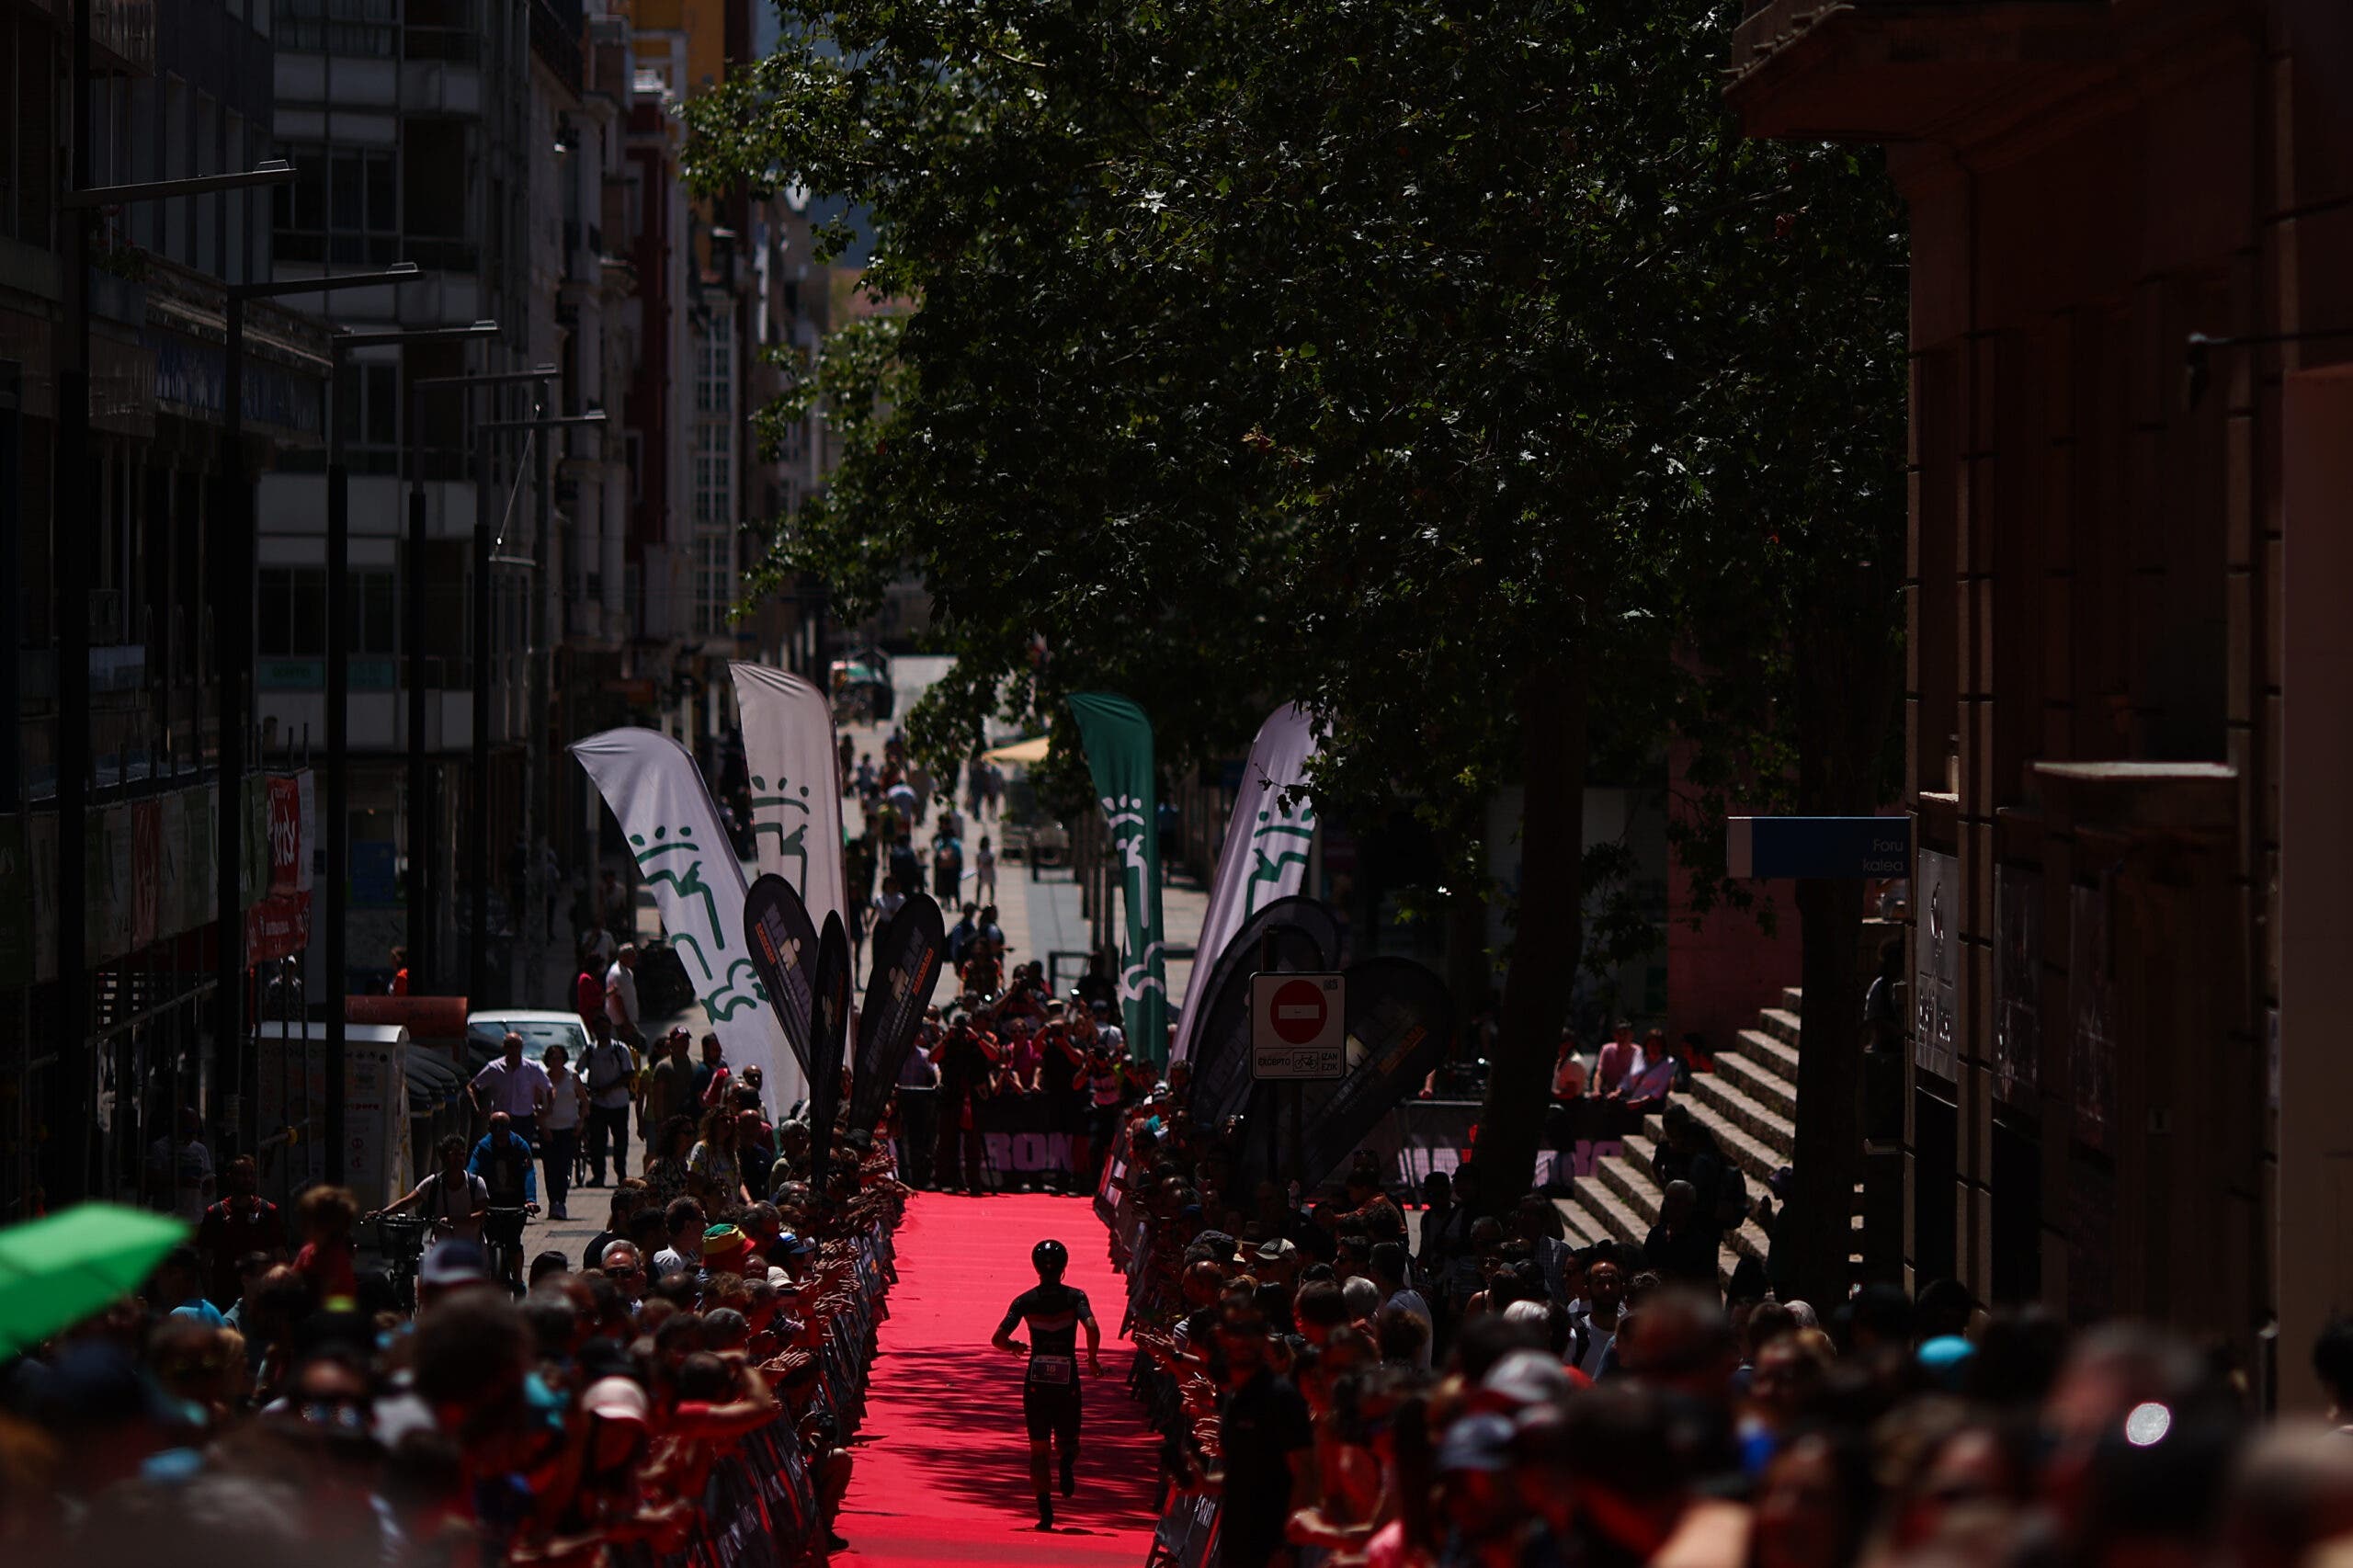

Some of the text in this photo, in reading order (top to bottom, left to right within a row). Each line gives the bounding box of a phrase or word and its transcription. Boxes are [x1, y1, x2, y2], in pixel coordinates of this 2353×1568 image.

[1872, 838, 1904, 852] Foru
[1862, 858, 1904, 872] kalea
[1322, 1052, 1338, 1061] IZAN
[1257, 1058, 1291, 1066] EXCEPTO
[1322, 1062, 1338, 1071] EZIK
